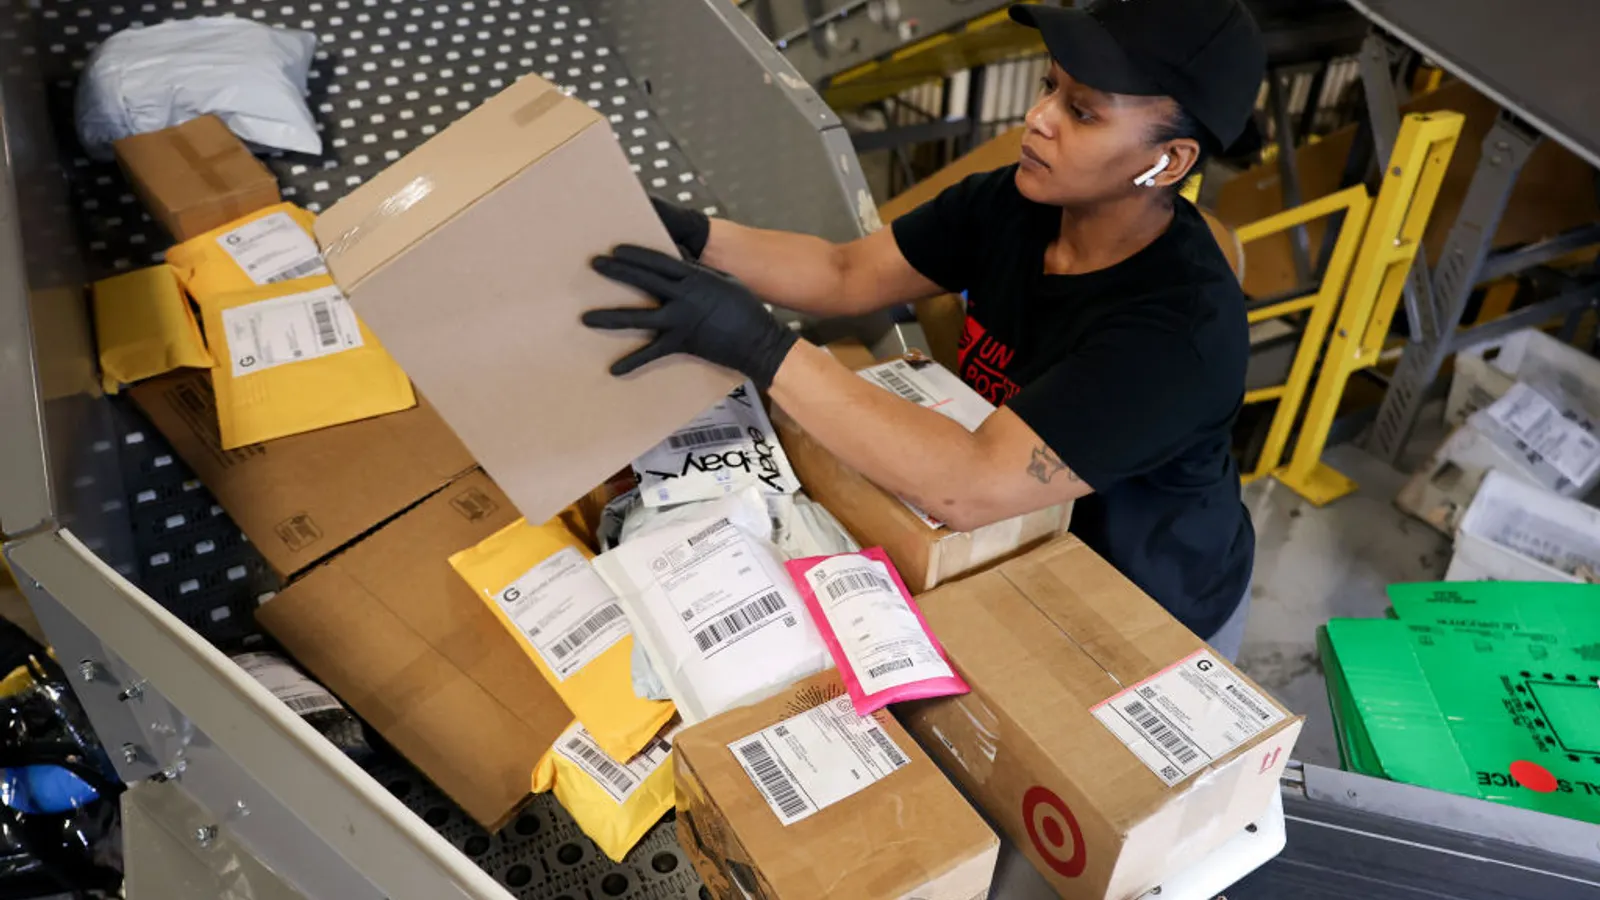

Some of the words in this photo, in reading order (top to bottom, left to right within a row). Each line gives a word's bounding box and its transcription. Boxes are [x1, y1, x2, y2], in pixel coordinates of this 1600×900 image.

[239, 355, 256, 368] G
[503, 587, 521, 602] G
[1196, 659, 1213, 672] G
